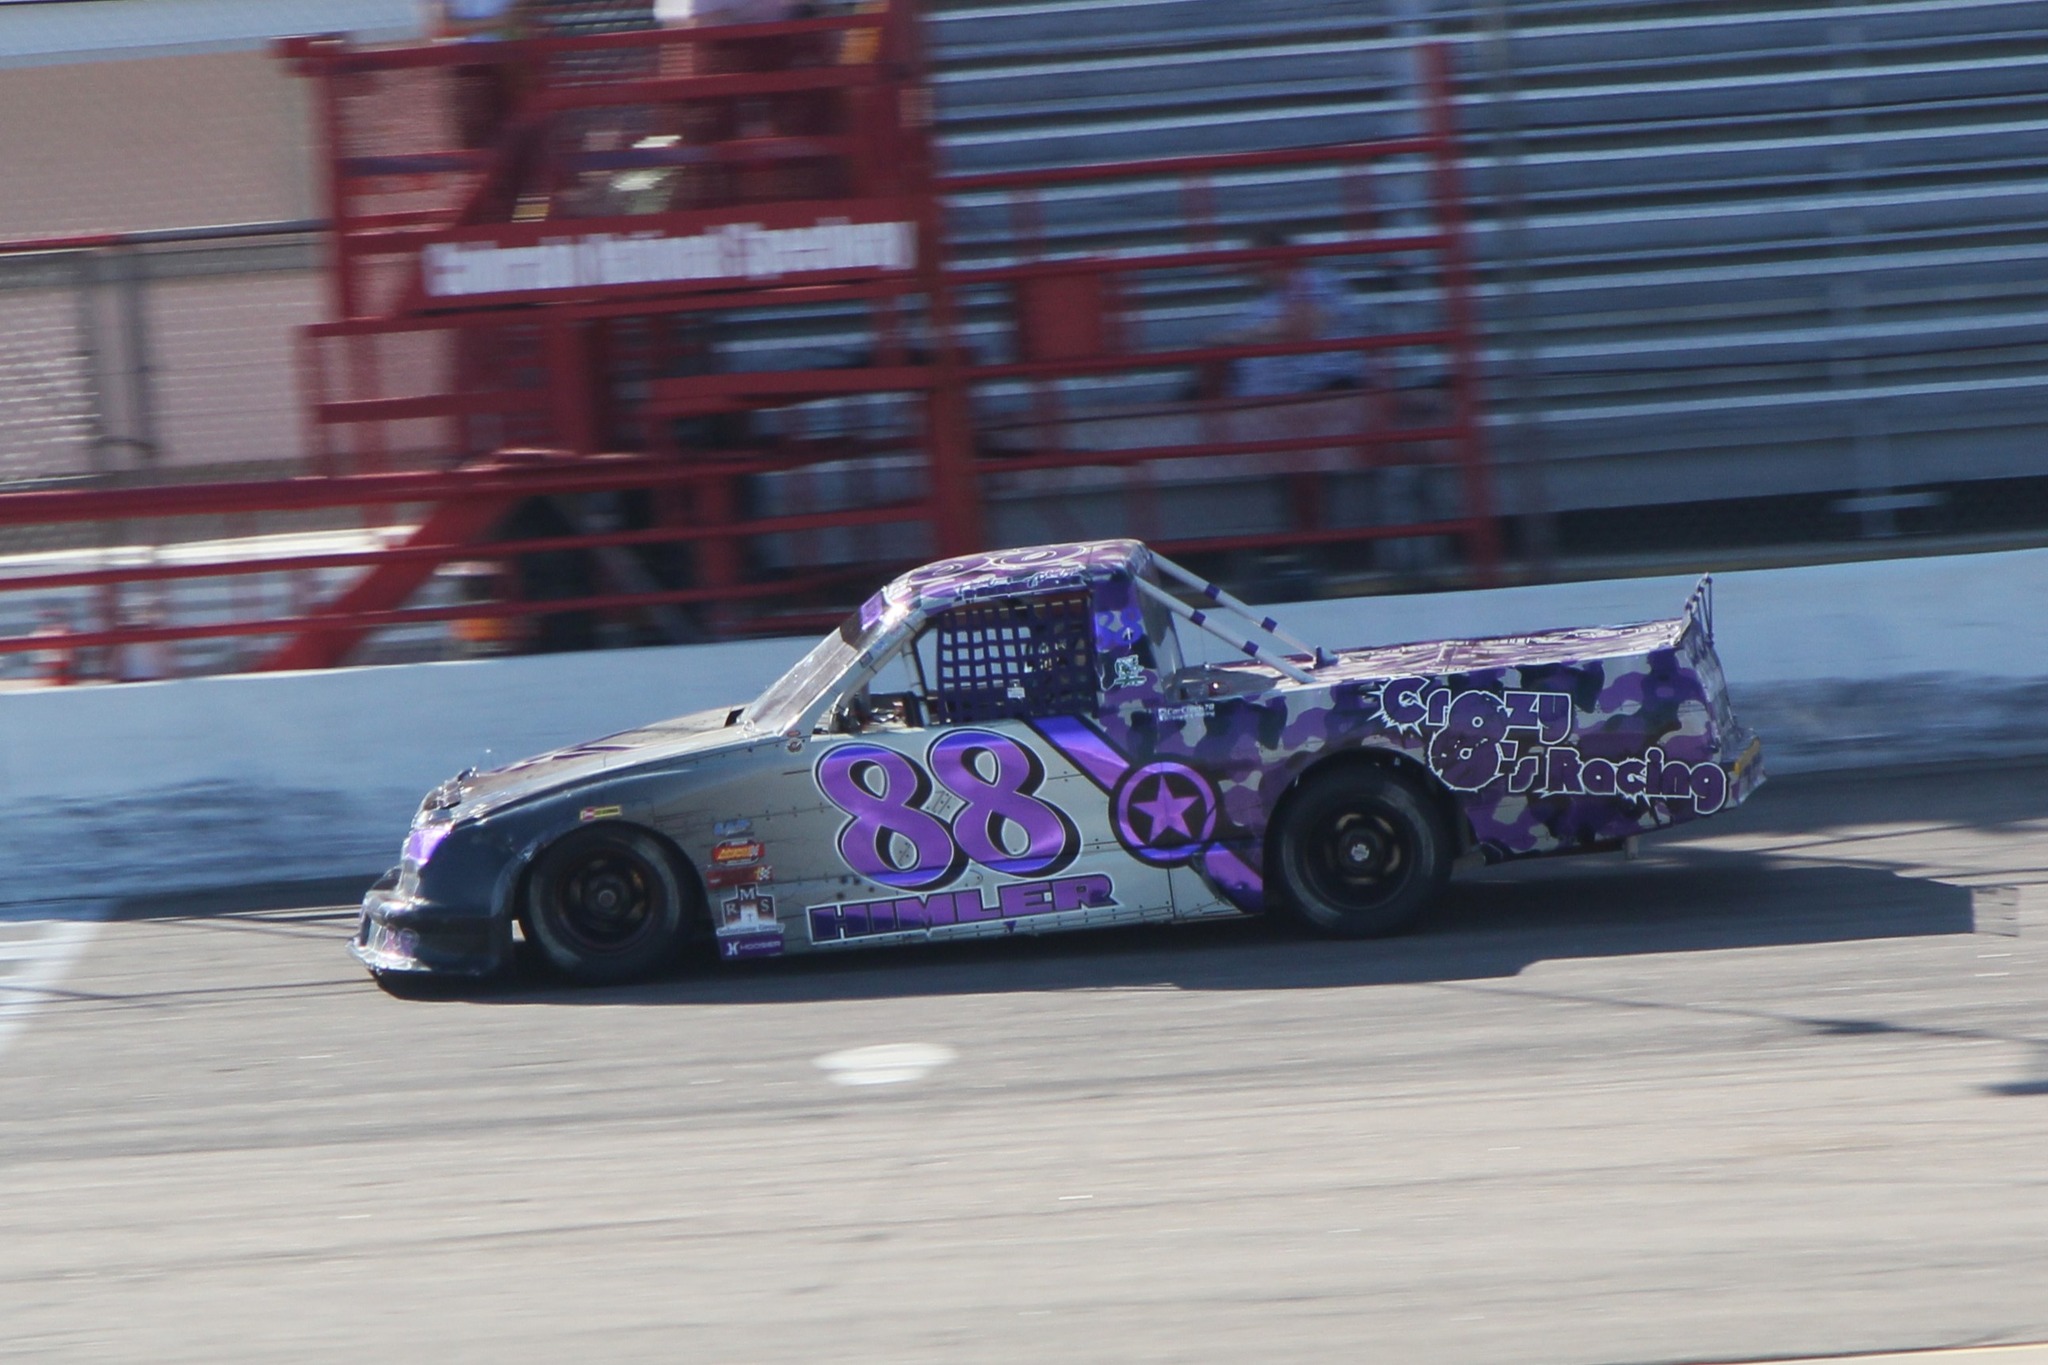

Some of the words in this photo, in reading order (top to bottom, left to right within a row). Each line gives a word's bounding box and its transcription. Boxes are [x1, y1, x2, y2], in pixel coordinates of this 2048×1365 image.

[813, 727, 1081, 892] 88
[1543, 747, 1726, 814] Racing
[807, 874, 1120, 943] HIMLER
